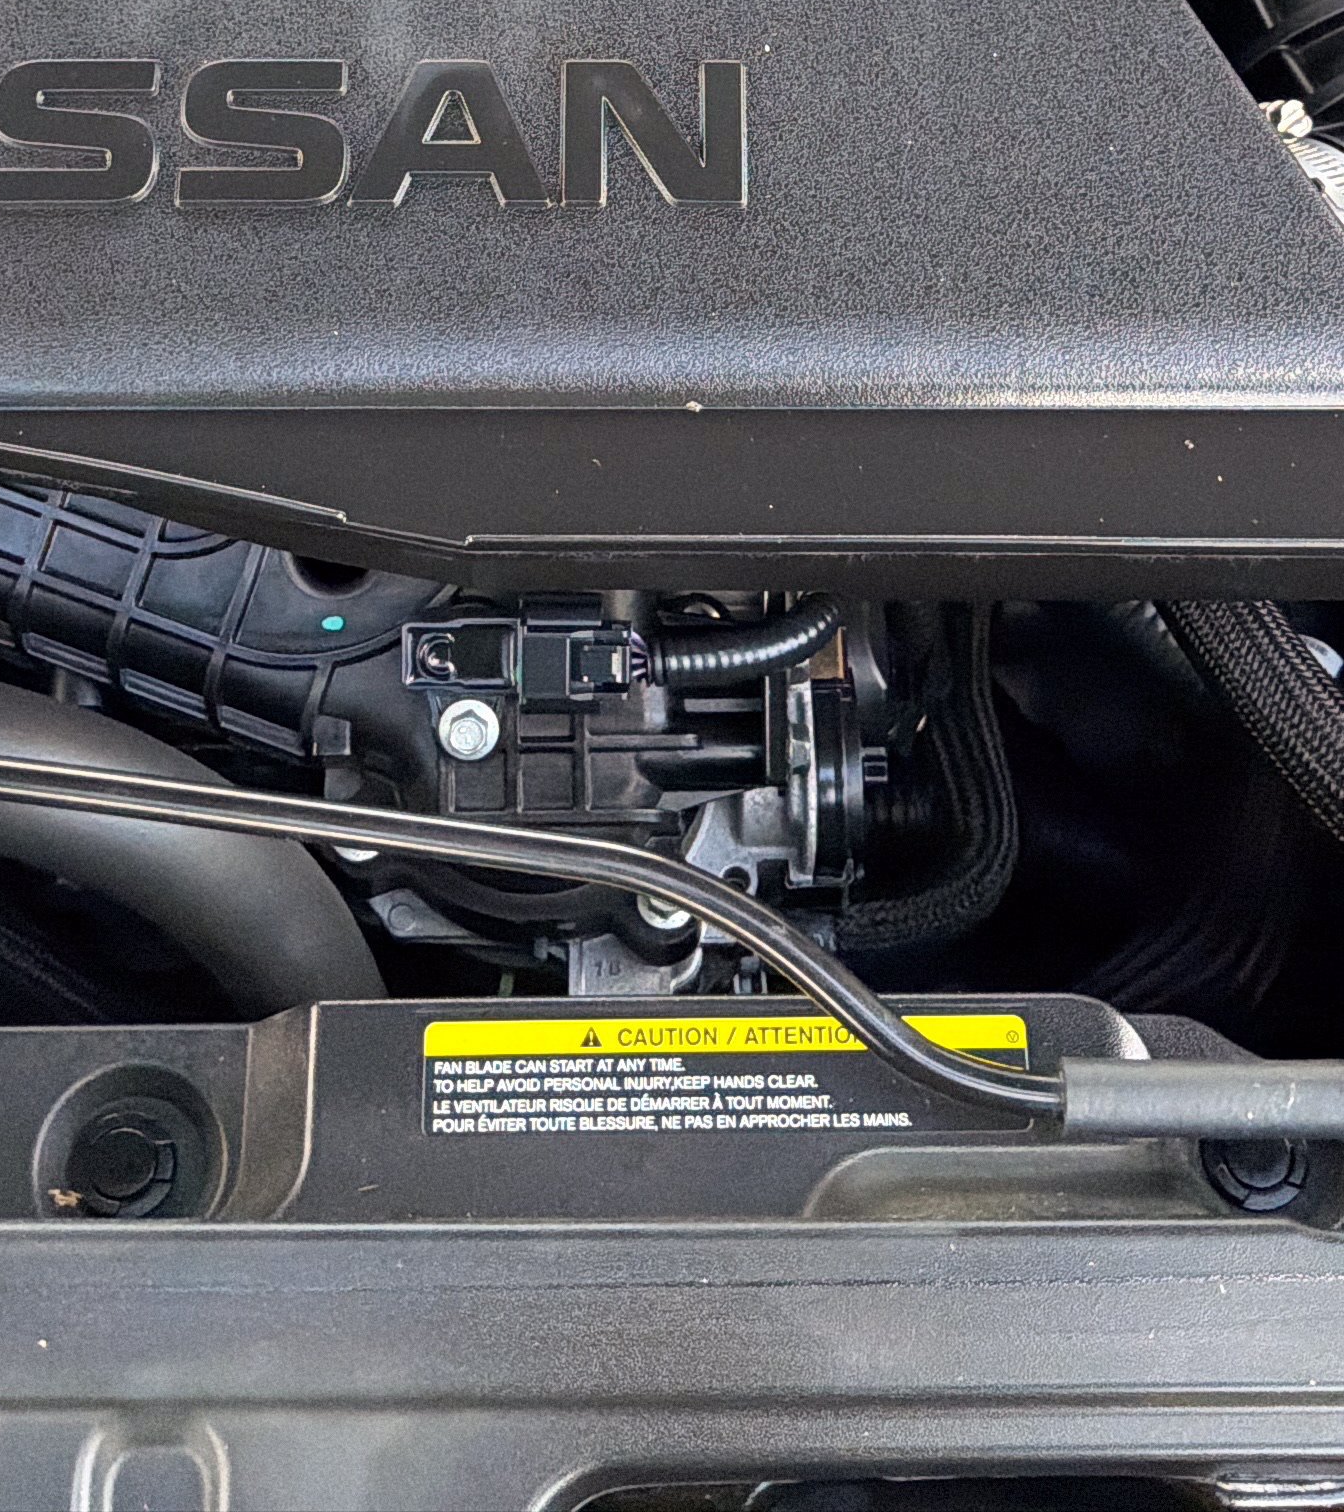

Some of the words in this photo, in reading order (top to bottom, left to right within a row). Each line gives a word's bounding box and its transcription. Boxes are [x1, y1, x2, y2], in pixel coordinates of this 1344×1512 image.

[617, 1026, 719, 1047] CAUTION
[726, 1026, 737, 1046] /
[744, 1025, 858, 1045] ATTENTIO
[434, 1059, 462, 1076] FAN
[465, 1059, 512, 1076] BLADE
[515, 1058, 546, 1075] CAN
[550, 1058, 595, 1075] START
[597, 1057, 615, 1074] AT
[617, 1057, 647, 1074] ANY
[649, 1056, 685, 1073] TIME.
[434, 1078, 454, 1094] TO
[456, 1077, 494, 1094] HELP
[496, 1076, 540, 1093] AVOID
[543, 1075, 621, 1093] PERSONAL
[714, 1073, 764, 1090] HANDS
[768, 1072, 818, 1090] CLEAR.
[433, 1099, 450, 1115] LE
[454, 1097, 547, 1115] VENTILATEUR
[550, 1096, 604, 1114] RISQUE
[607, 1096, 627, 1113] DE
[630, 1090, 710, 1113] DÉMARRER
[712, 1090, 723, 1111] À
[725, 1094, 763, 1111] TOUT
[766, 1093, 833, 1111] MOMENT.
[433, 1117, 474, 1134] POUR
[478, 1112, 527, 1134] ÉVITER
[530, 1116, 576, 1133] TOUTE
[579, 1115, 658, 1135] BLESSURE,
[662, 1114, 682, 1131] NE
[685, 1114, 714, 1131] PAS
[717, 1114, 736, 1130] EN
[739, 1112, 830, 1130] APPROCHER
[833, 1112, 860, 1129] LES
[863, 1111, 913, 1128] MAINS.
